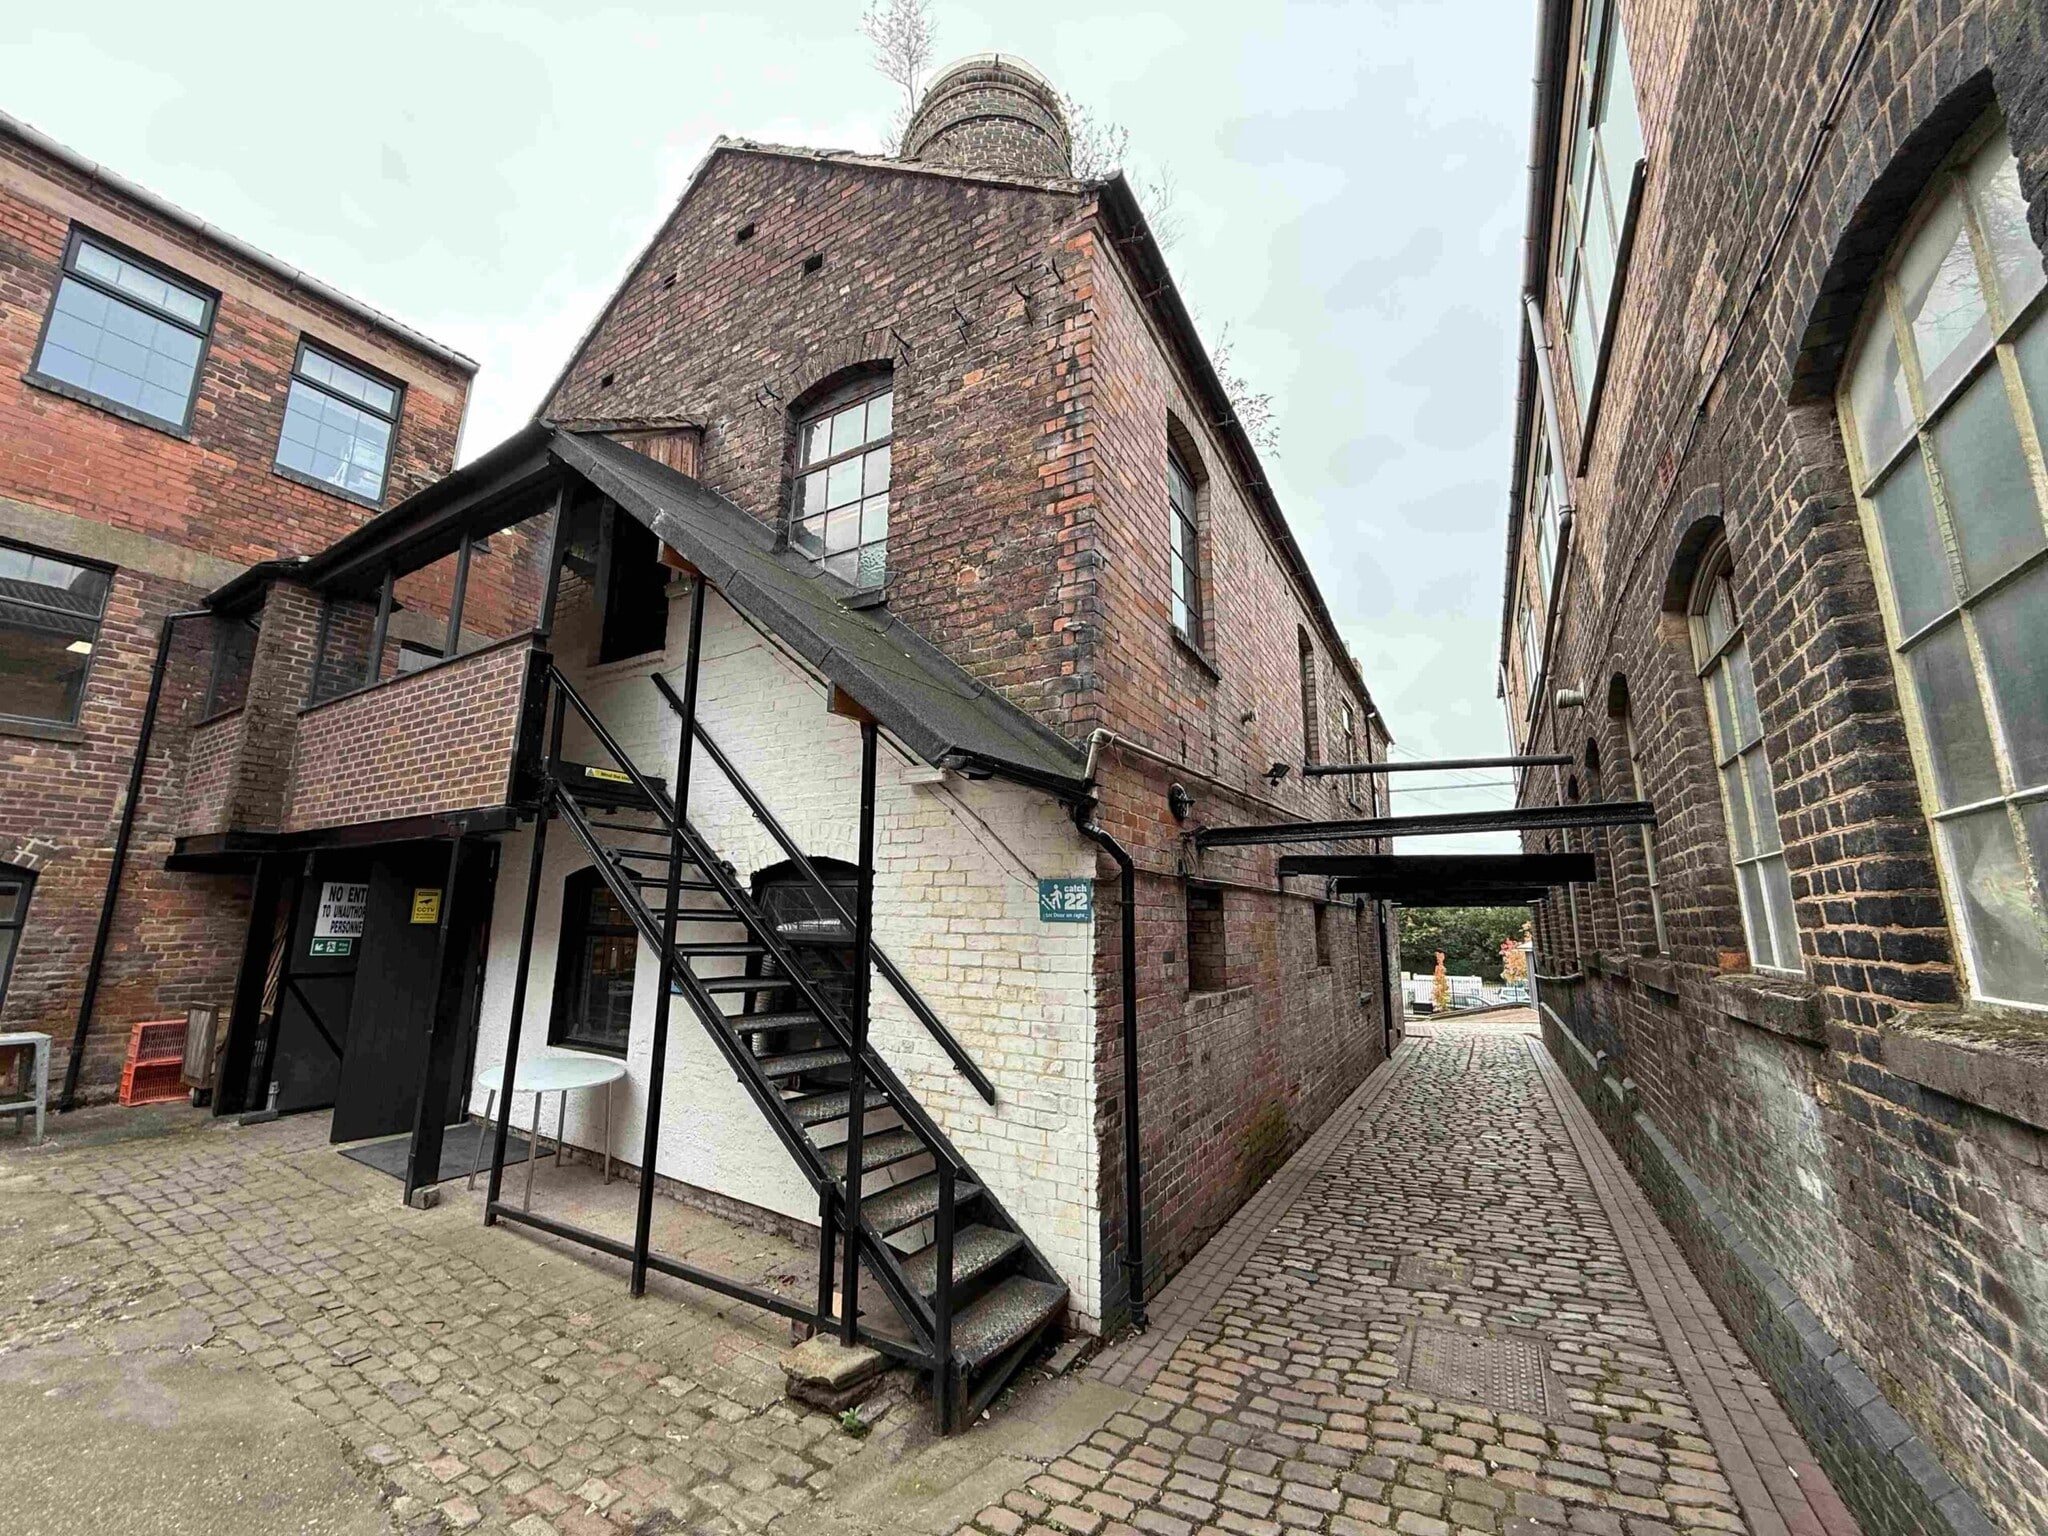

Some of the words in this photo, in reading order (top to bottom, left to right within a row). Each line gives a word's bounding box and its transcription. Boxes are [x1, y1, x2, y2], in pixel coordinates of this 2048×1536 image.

[328, 886, 344, 902] NO
[347, 886, 368, 903] ENT
[1064, 883, 1087, 892] catch
[1064, 892, 1088, 910] 22
[322, 904, 331, 918] TO
[329, 920, 363, 934] PERSONNE
